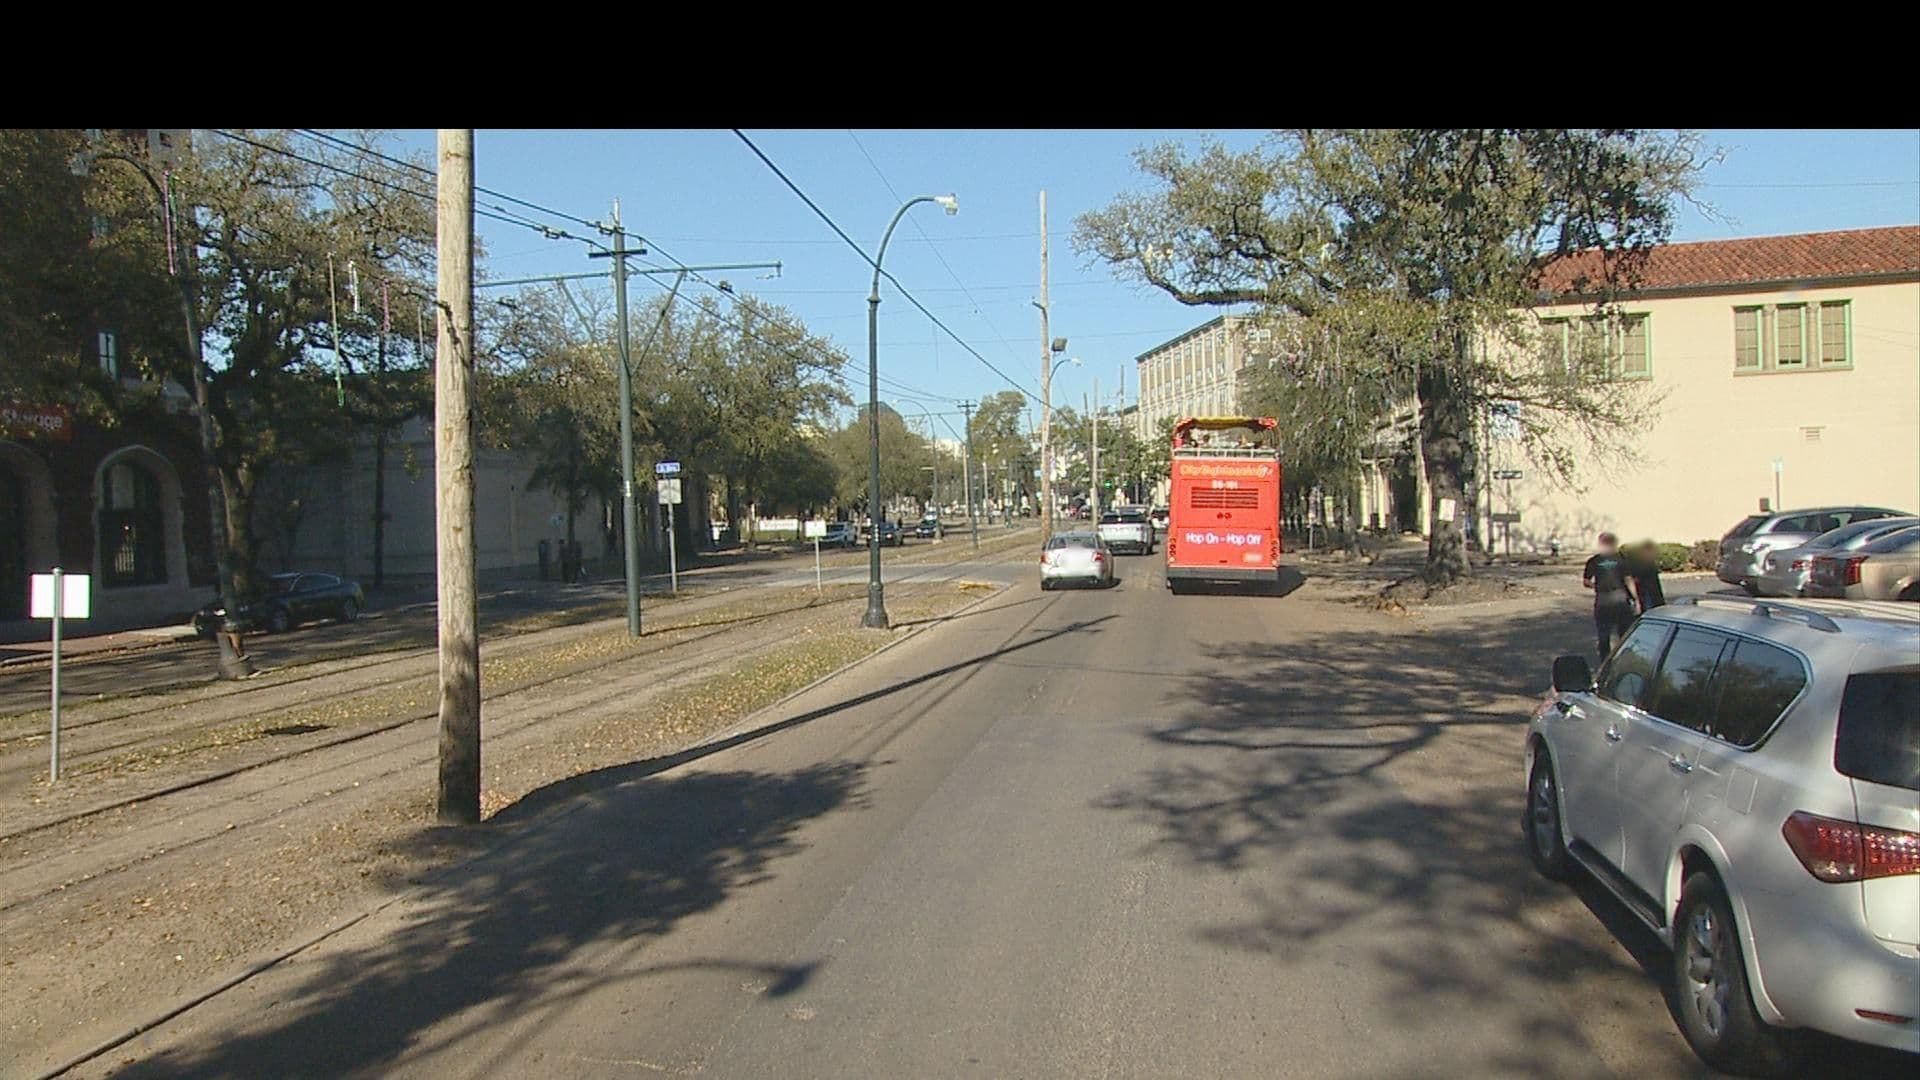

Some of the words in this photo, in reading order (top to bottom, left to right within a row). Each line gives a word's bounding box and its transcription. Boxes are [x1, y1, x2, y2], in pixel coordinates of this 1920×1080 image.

[1185, 532, 1204, 544] Hop
[1205, 533, 1219, 544] On
[1226, 533, 1245, 545] Hop
[1246, 534, 1262, 545] Off
